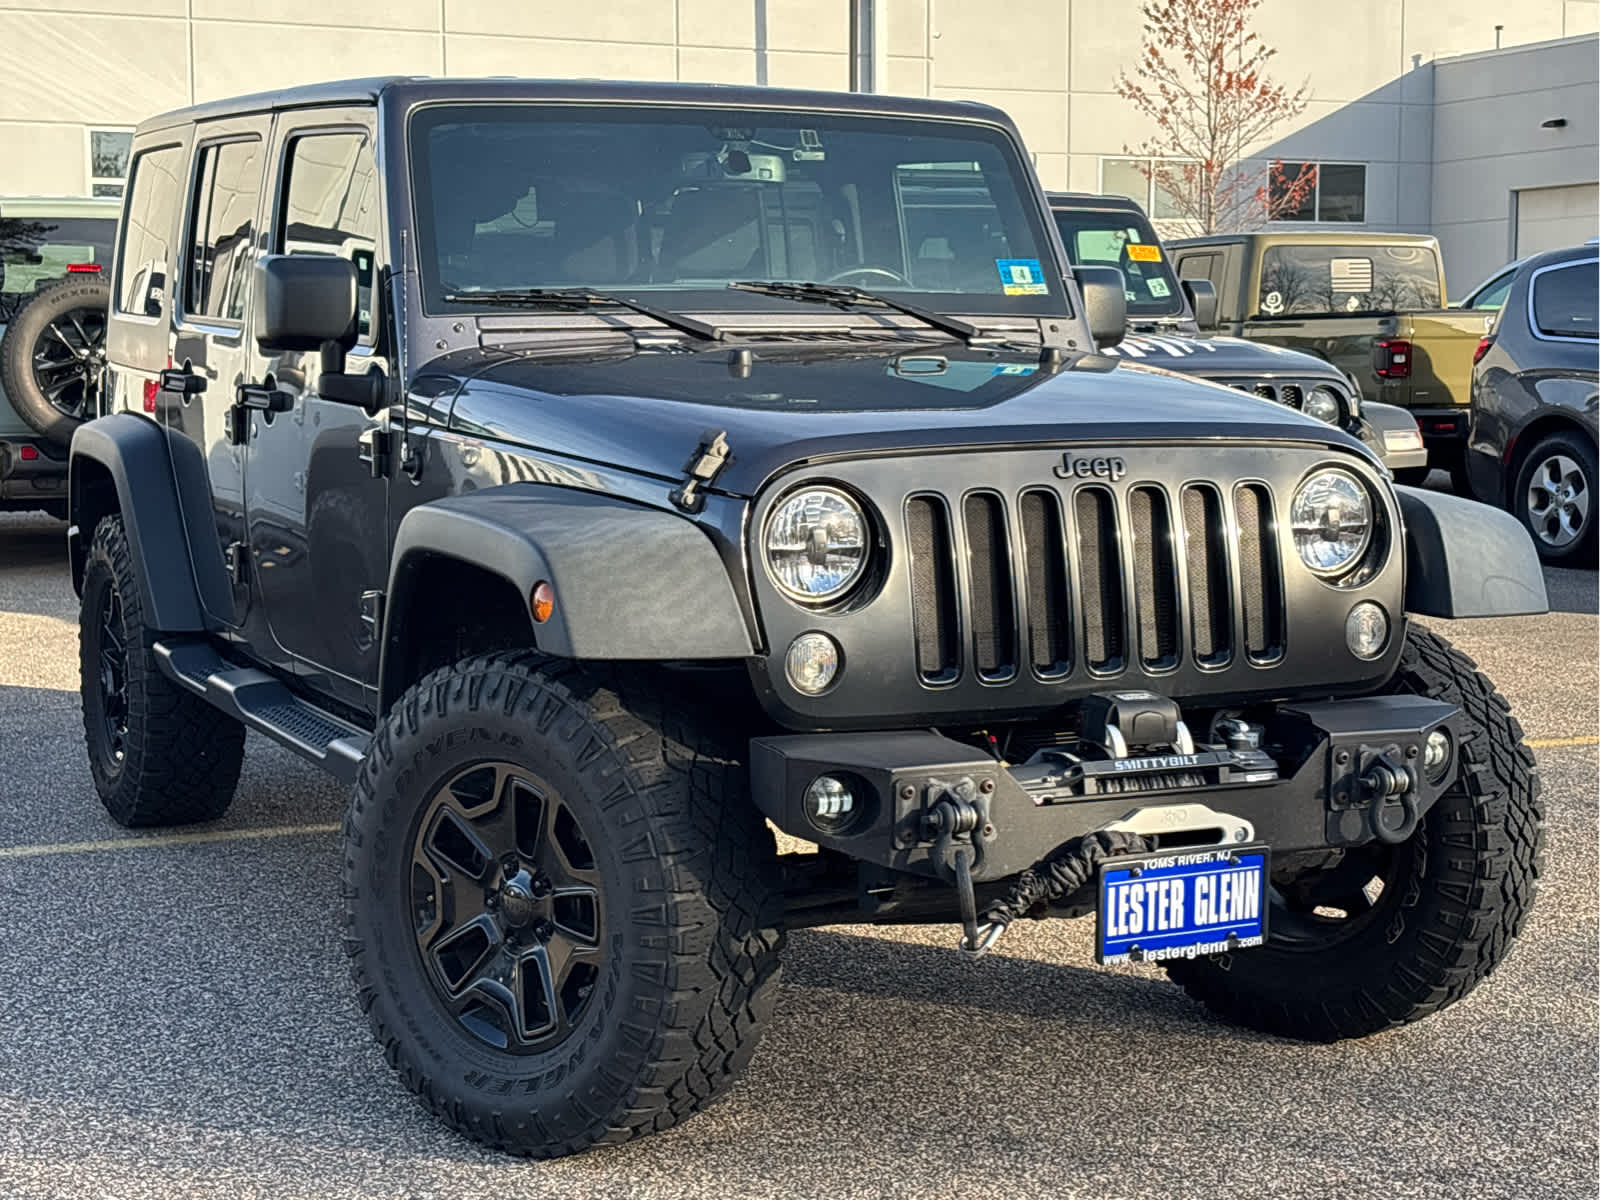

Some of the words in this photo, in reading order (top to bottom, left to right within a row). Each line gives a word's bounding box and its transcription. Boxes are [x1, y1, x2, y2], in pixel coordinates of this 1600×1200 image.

[51, 288, 100, 304] NEXEN
[1052, 452, 1126, 482] Jeep
[1114, 755, 1200, 771] SMITTYBILT
[1143, 856, 1175, 871] TOMS
[1216, 849, 1232, 861] NJ
[1106, 878, 1186, 938] LESTER
[1194, 869, 1260, 926] GLENN
